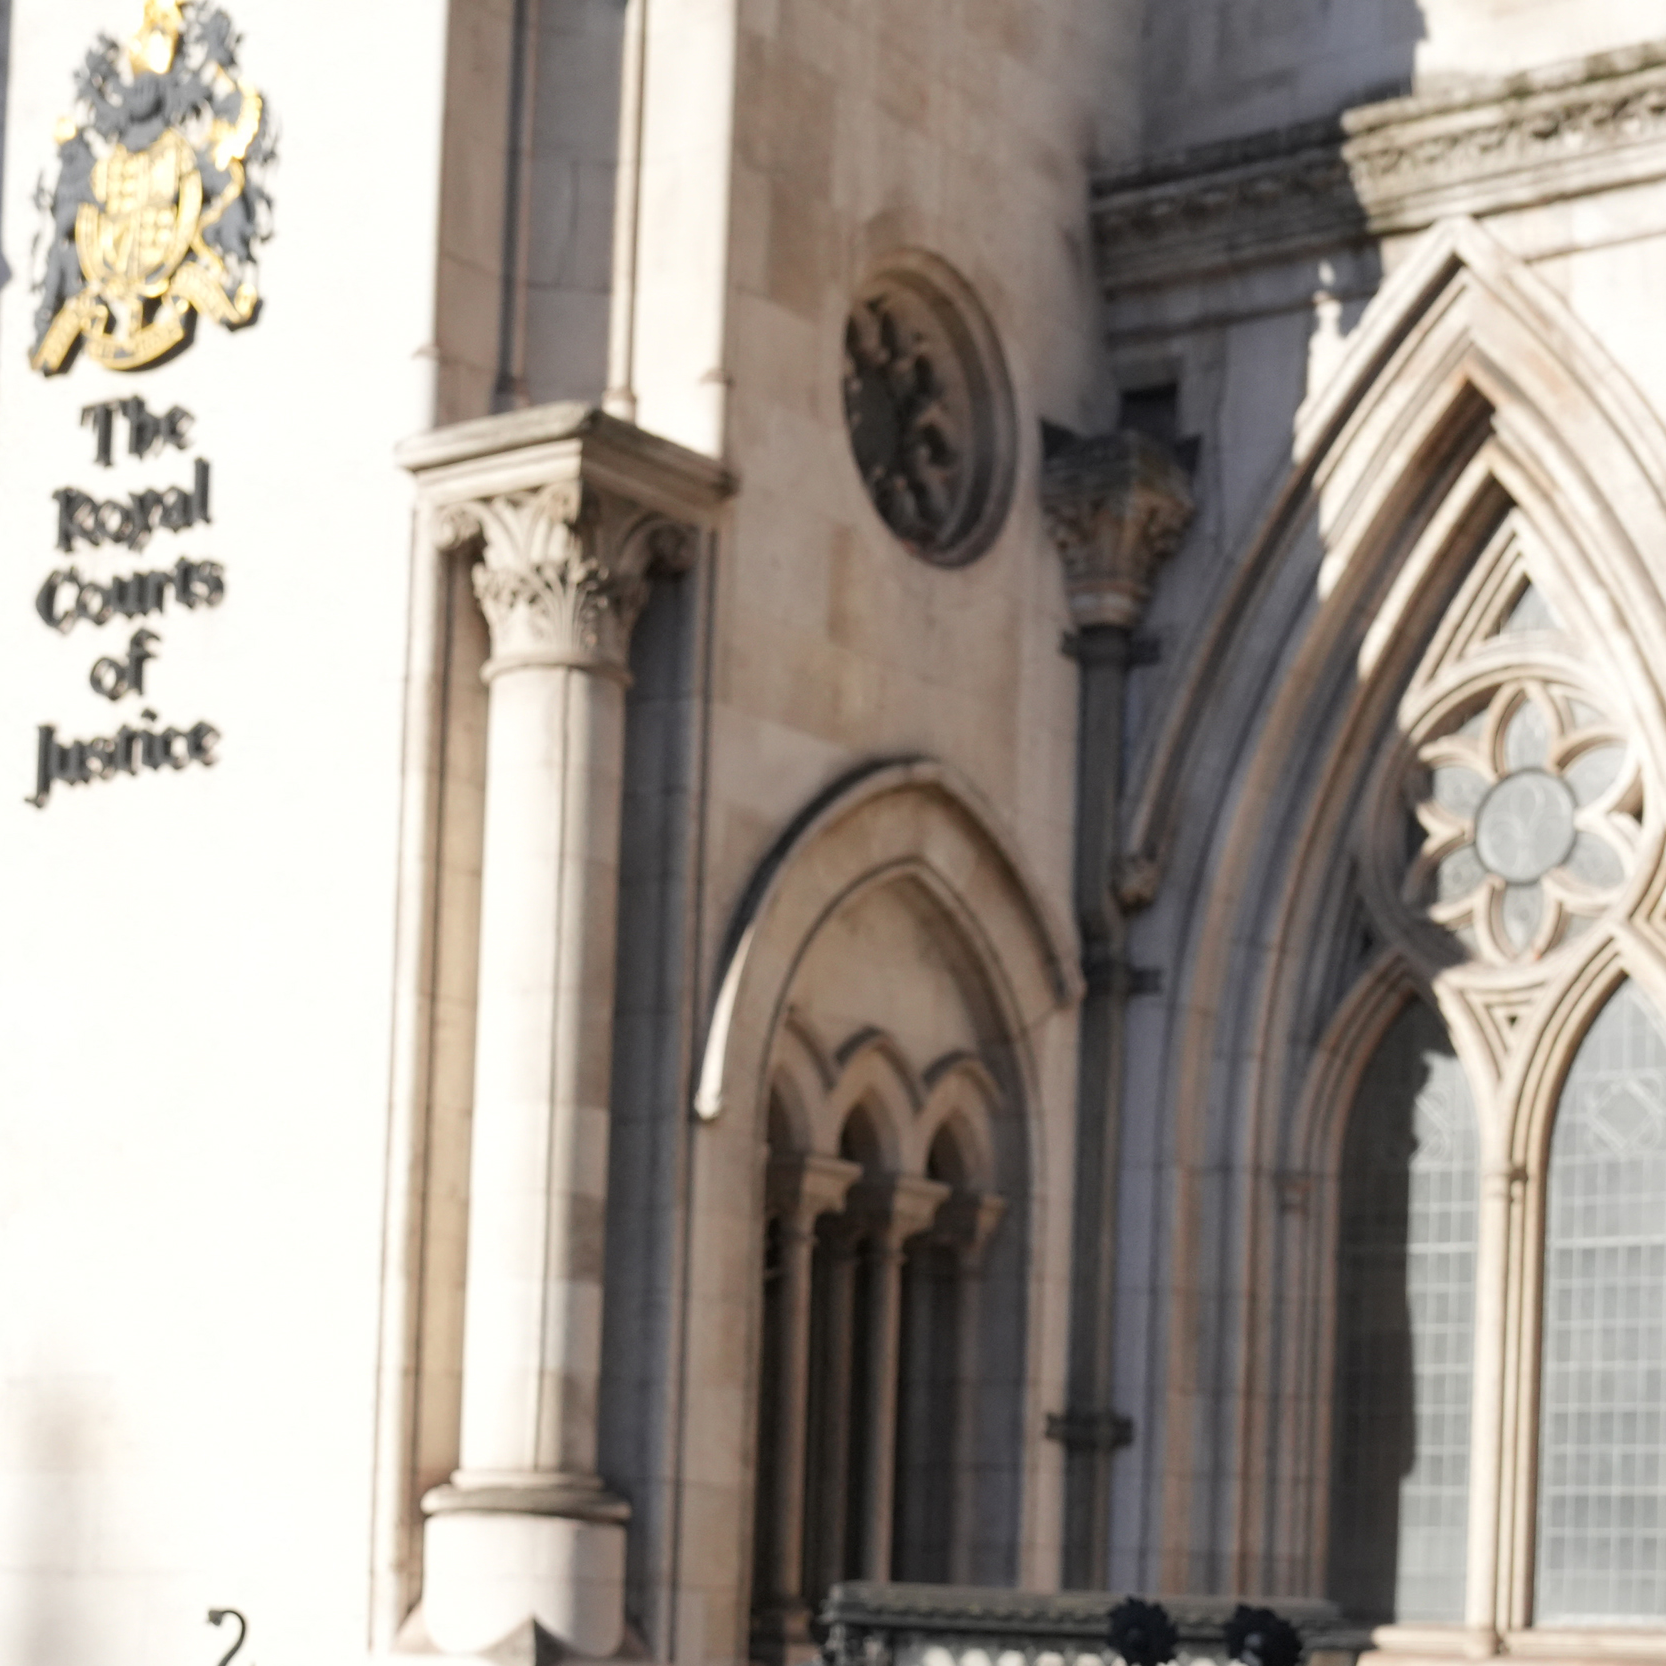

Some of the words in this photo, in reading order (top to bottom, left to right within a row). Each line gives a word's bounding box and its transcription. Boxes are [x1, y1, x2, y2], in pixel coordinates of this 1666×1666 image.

[80, 395, 196, 467] The
[51, 457, 211, 554] Royal
[35, 556, 225, 635] Courts
[89, 627, 162, 701] of
[24, 708, 222, 809] Justice
